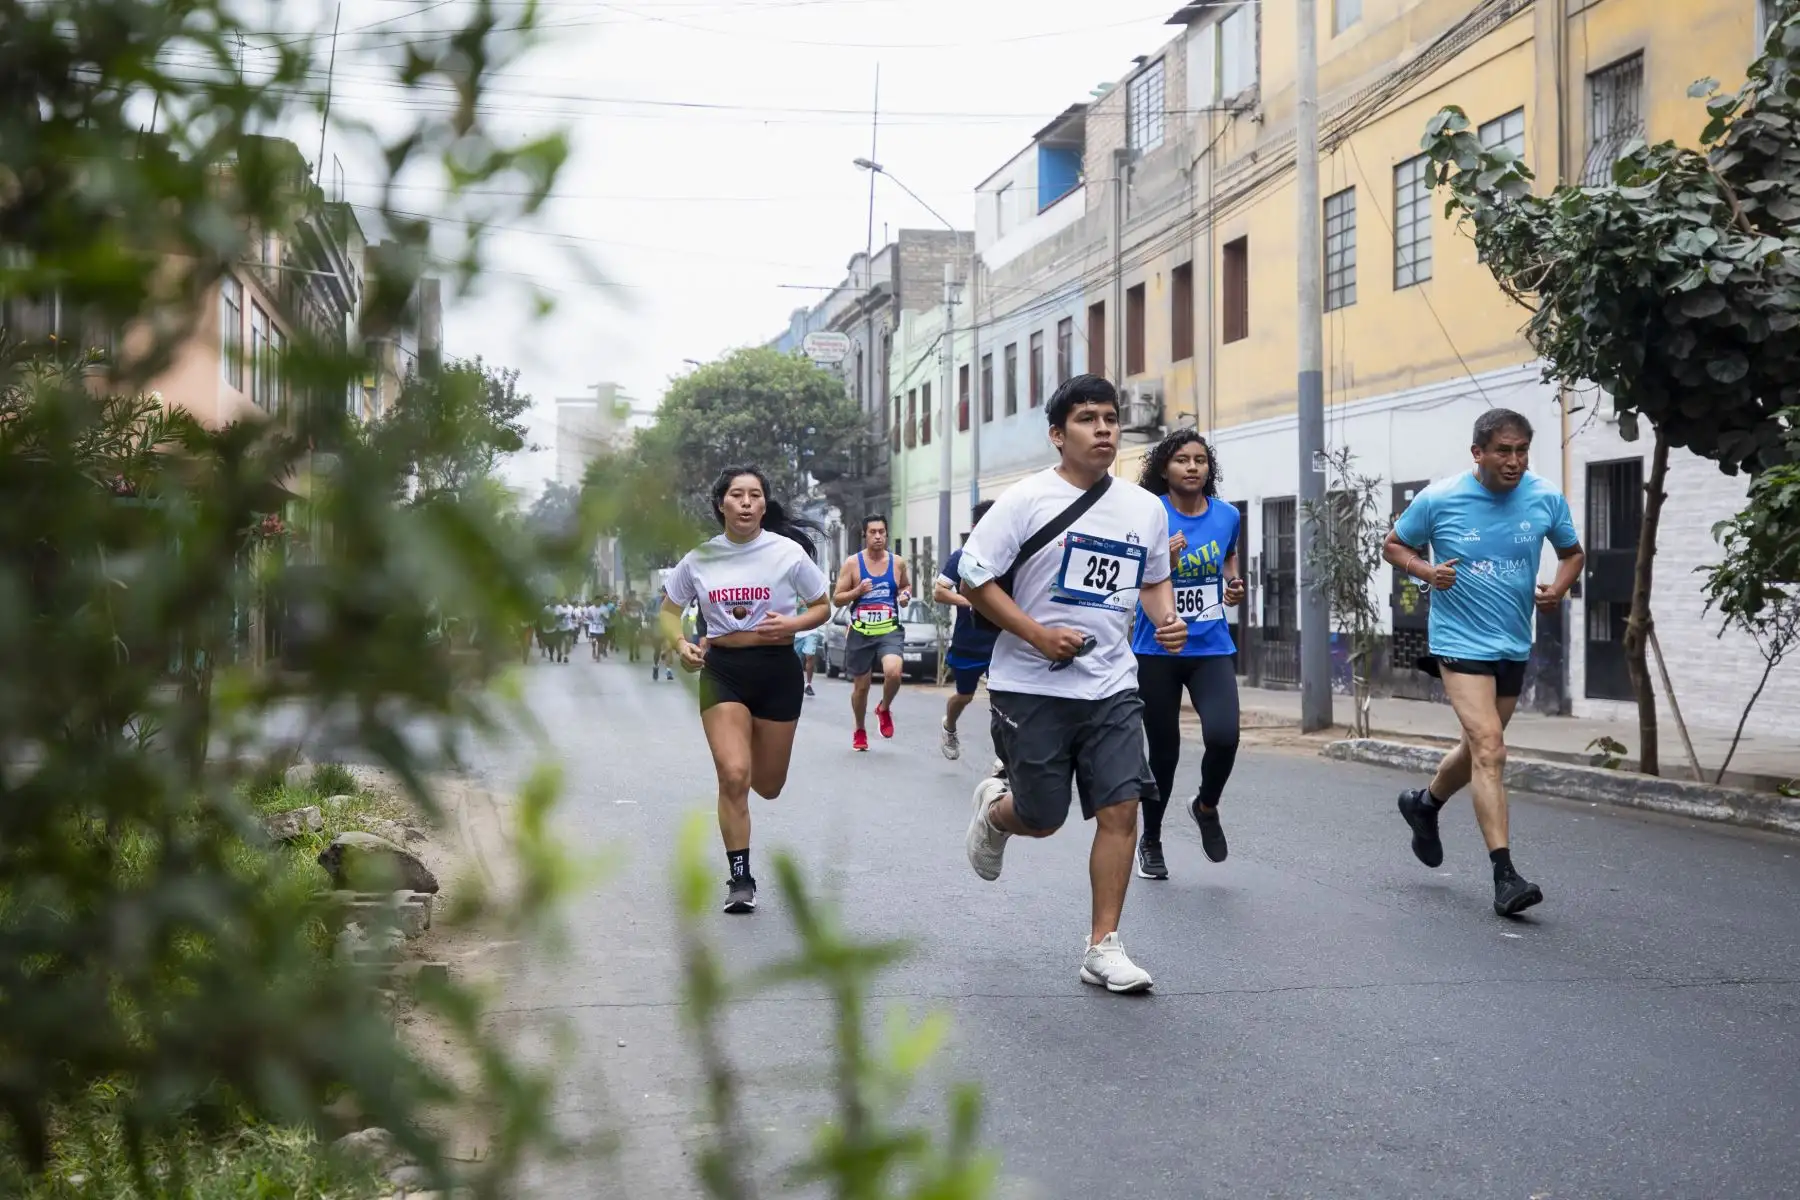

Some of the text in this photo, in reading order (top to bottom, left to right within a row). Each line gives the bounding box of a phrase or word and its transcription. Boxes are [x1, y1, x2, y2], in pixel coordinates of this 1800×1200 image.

[1176, 539, 1221, 575] ENTA
[1498, 558, 1527, 570] LIMA
[1083, 555, 1120, 592] 252
[708, 586, 771, 604] MISTERIOS
[1176, 588, 1204, 614] 566
[867, 611, 882, 623] 773
